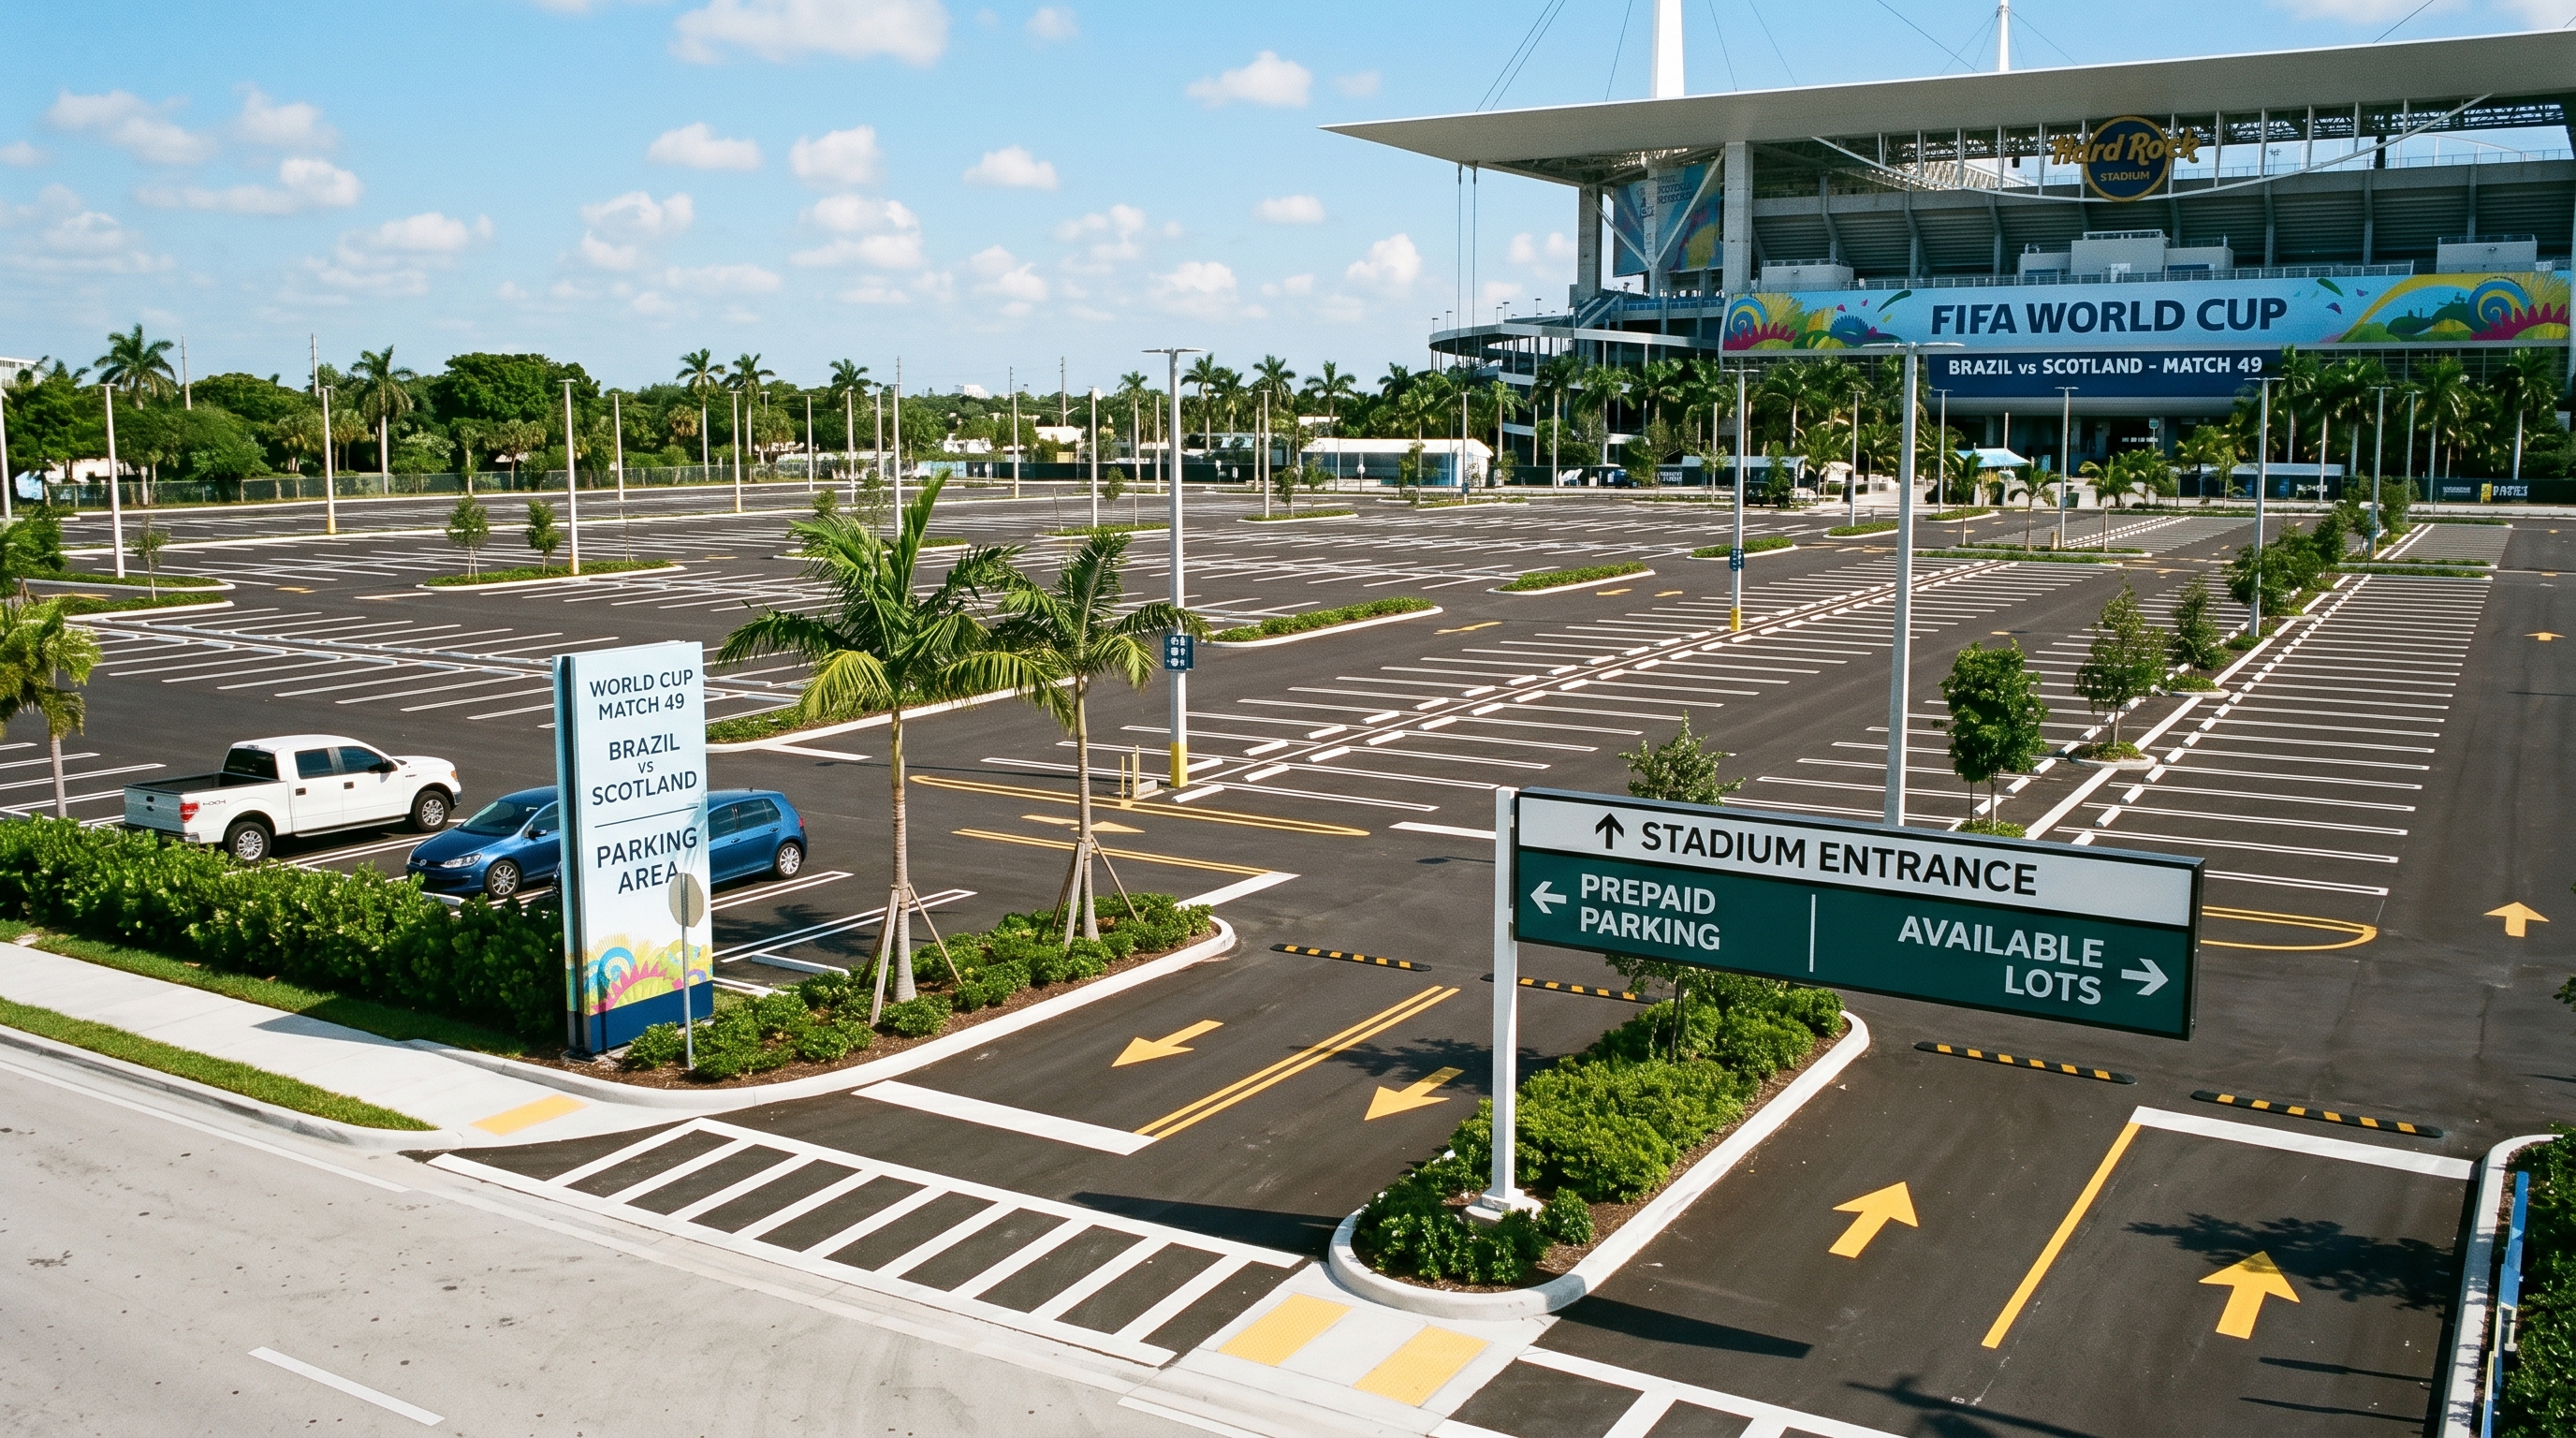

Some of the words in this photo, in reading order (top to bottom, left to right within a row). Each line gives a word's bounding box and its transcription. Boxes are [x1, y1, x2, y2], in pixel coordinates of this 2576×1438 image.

[2052, 134, 2125, 165] Hard
[2127, 126, 2201, 166] Rock
[2100, 170, 2150, 182] STADIUM
[1931, 303, 2018, 335] FIFA
[2026, 299, 2186, 334] WORLD
[2196, 297, 2288, 331] CUP
[1949, 359, 2013, 375] BRAZIL
[2018, 362, 2037, 375] vs
[2042, 358, 2143, 374] SCOTLAND
[2163, 357, 2231, 374] MATCH
[2238, 356, 2263, 374] 49
[589, 674, 655, 697] WORLD
[659, 668, 694, 688] CUP
[598, 696, 660, 721] MATCH
[664, 693, 685, 712] 49
[609, 732, 681, 761] BRAZIL
[637, 761, 654, 774] VS
[592, 770, 697, 806] SCOTLAND
[596, 827, 697, 869] PARKING
[1641, 821, 1806, 870] STADIUM
[1819, 841, 2039, 897] ENTRANCE
[618, 860, 679, 894] AREA
[1580, 873, 1716, 916] PREPAID
[1579, 906, 1721, 951] PARKING
[1897, 916, 2104, 970] AVAILABLE
[2005, 964, 2102, 1005] LOTS
